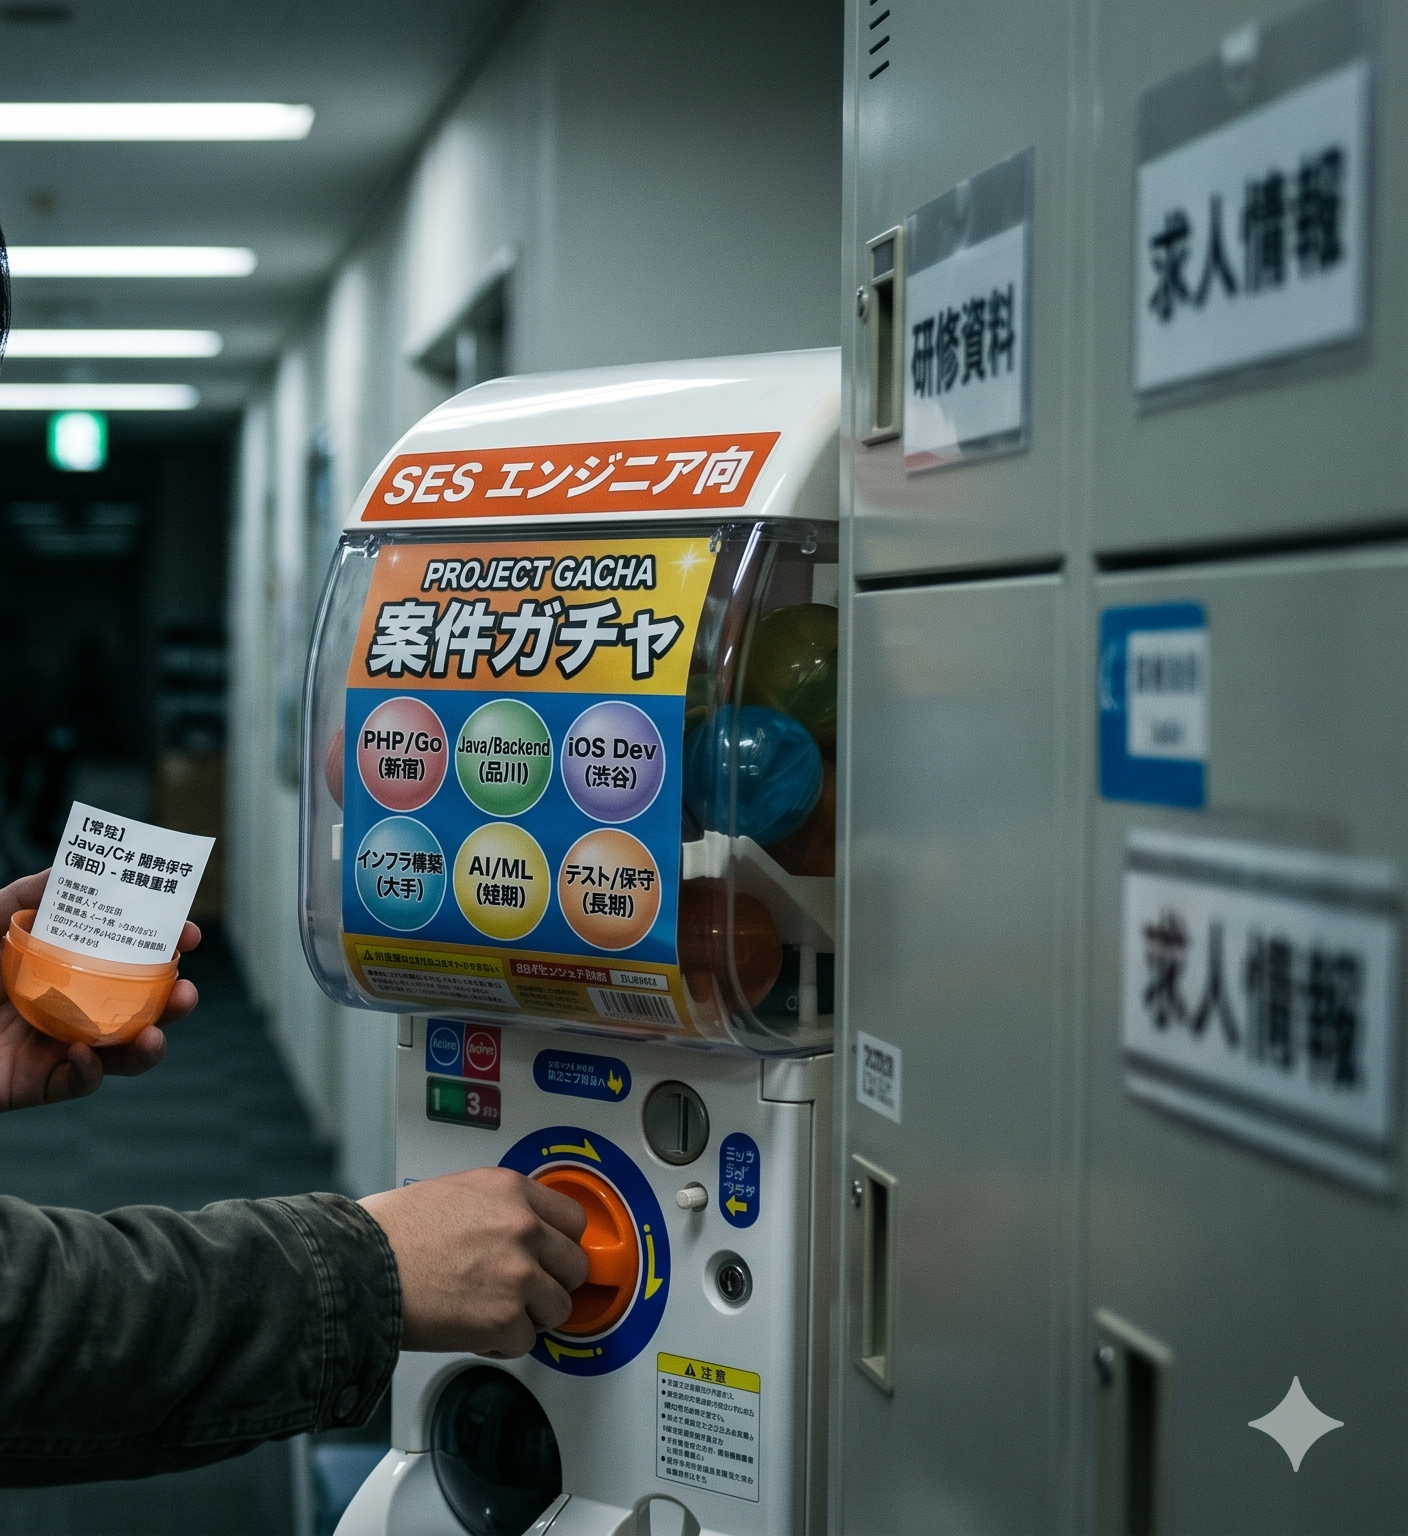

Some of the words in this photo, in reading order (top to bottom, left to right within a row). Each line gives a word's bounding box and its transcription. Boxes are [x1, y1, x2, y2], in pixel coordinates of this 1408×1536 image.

[1149, 147, 1346, 323] 求人情報
[911, 283, 1016, 400] 研修資料
[383, 462, 482, 506] SES
[484, 446, 756, 499] エンジニア向
[424, 559, 551, 591] PROJECT
[555, 556, 654, 590] GACHA
[369, 600, 682, 675] 案件ガチャ
[363, 730, 443, 754] PHP/Go
[458, 736, 551, 757] Java/Backend
[568, 736, 606, 759] iOS
[613, 738, 657, 760] Dev
[378, 757, 425, 782] (新宿)
[479, 761, 529, 785] (品川)
[585, 764, 637, 790] (渋谷)
[68, 834, 136, 863] Java/C#
[357, 849, 443, 875] インフラ構築
[468, 855, 534, 881] AI/ML
[376, 876, 424, 901] (大手)
[565, 864, 655, 892] テスト/保守
[582, 891, 634, 918] (長期)
[467, 1092, 481, 1116] 3
